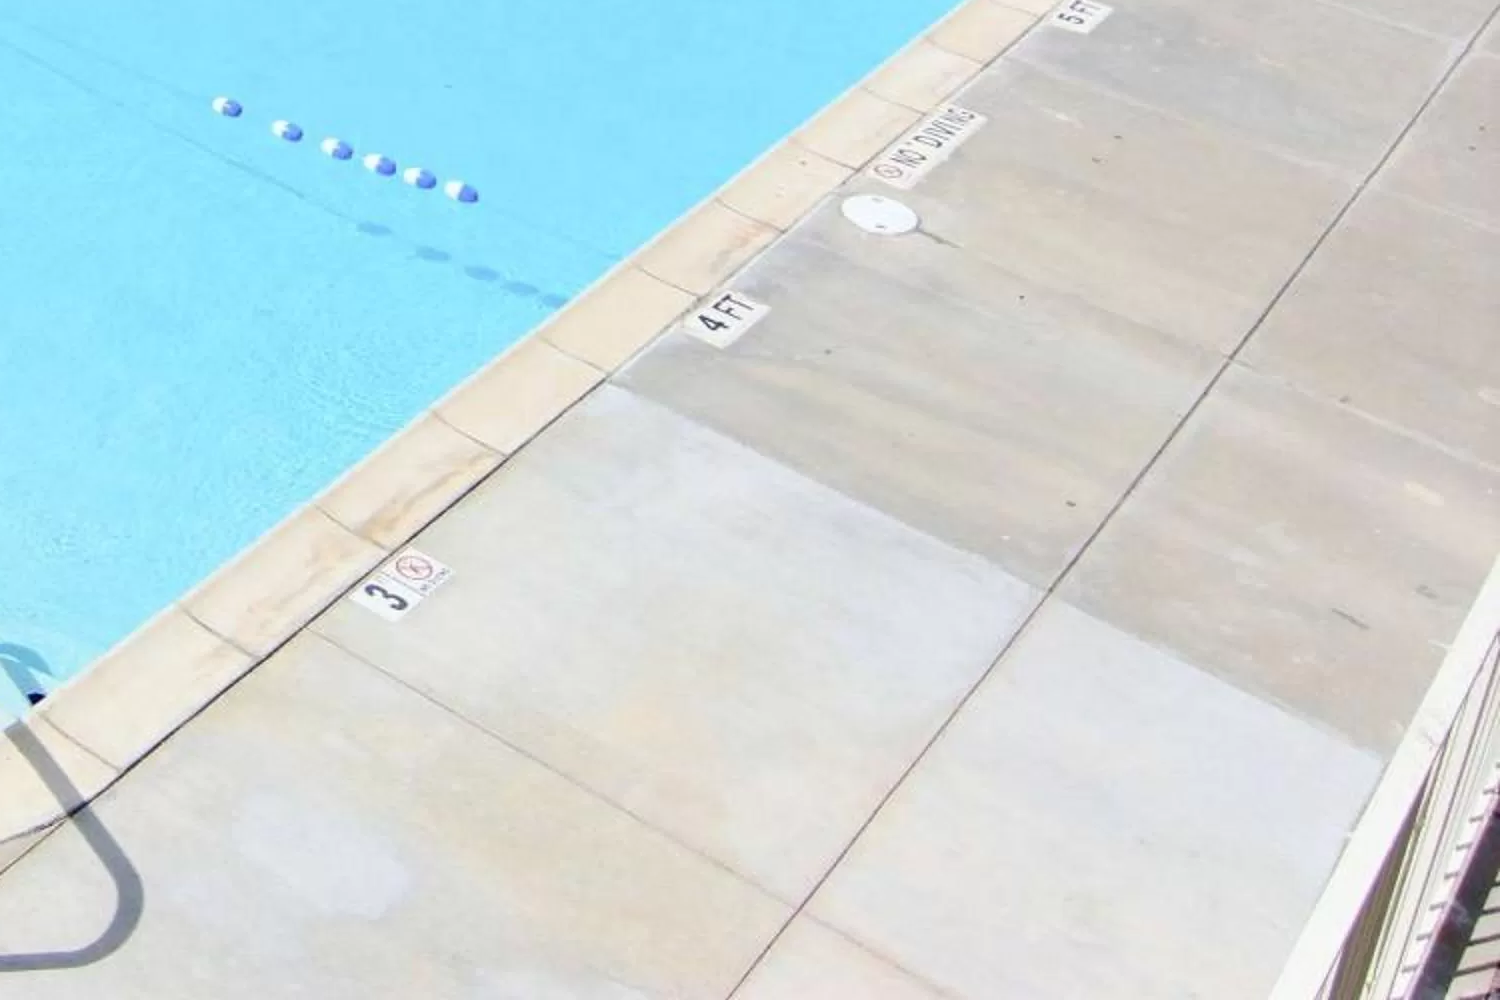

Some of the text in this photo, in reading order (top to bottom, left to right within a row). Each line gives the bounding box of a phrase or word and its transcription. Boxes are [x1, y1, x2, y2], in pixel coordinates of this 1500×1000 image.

[1057, 12, 1085, 25] 5
[698, 293, 756, 332] 4 FT
[364, 583, 409, 611] 3
